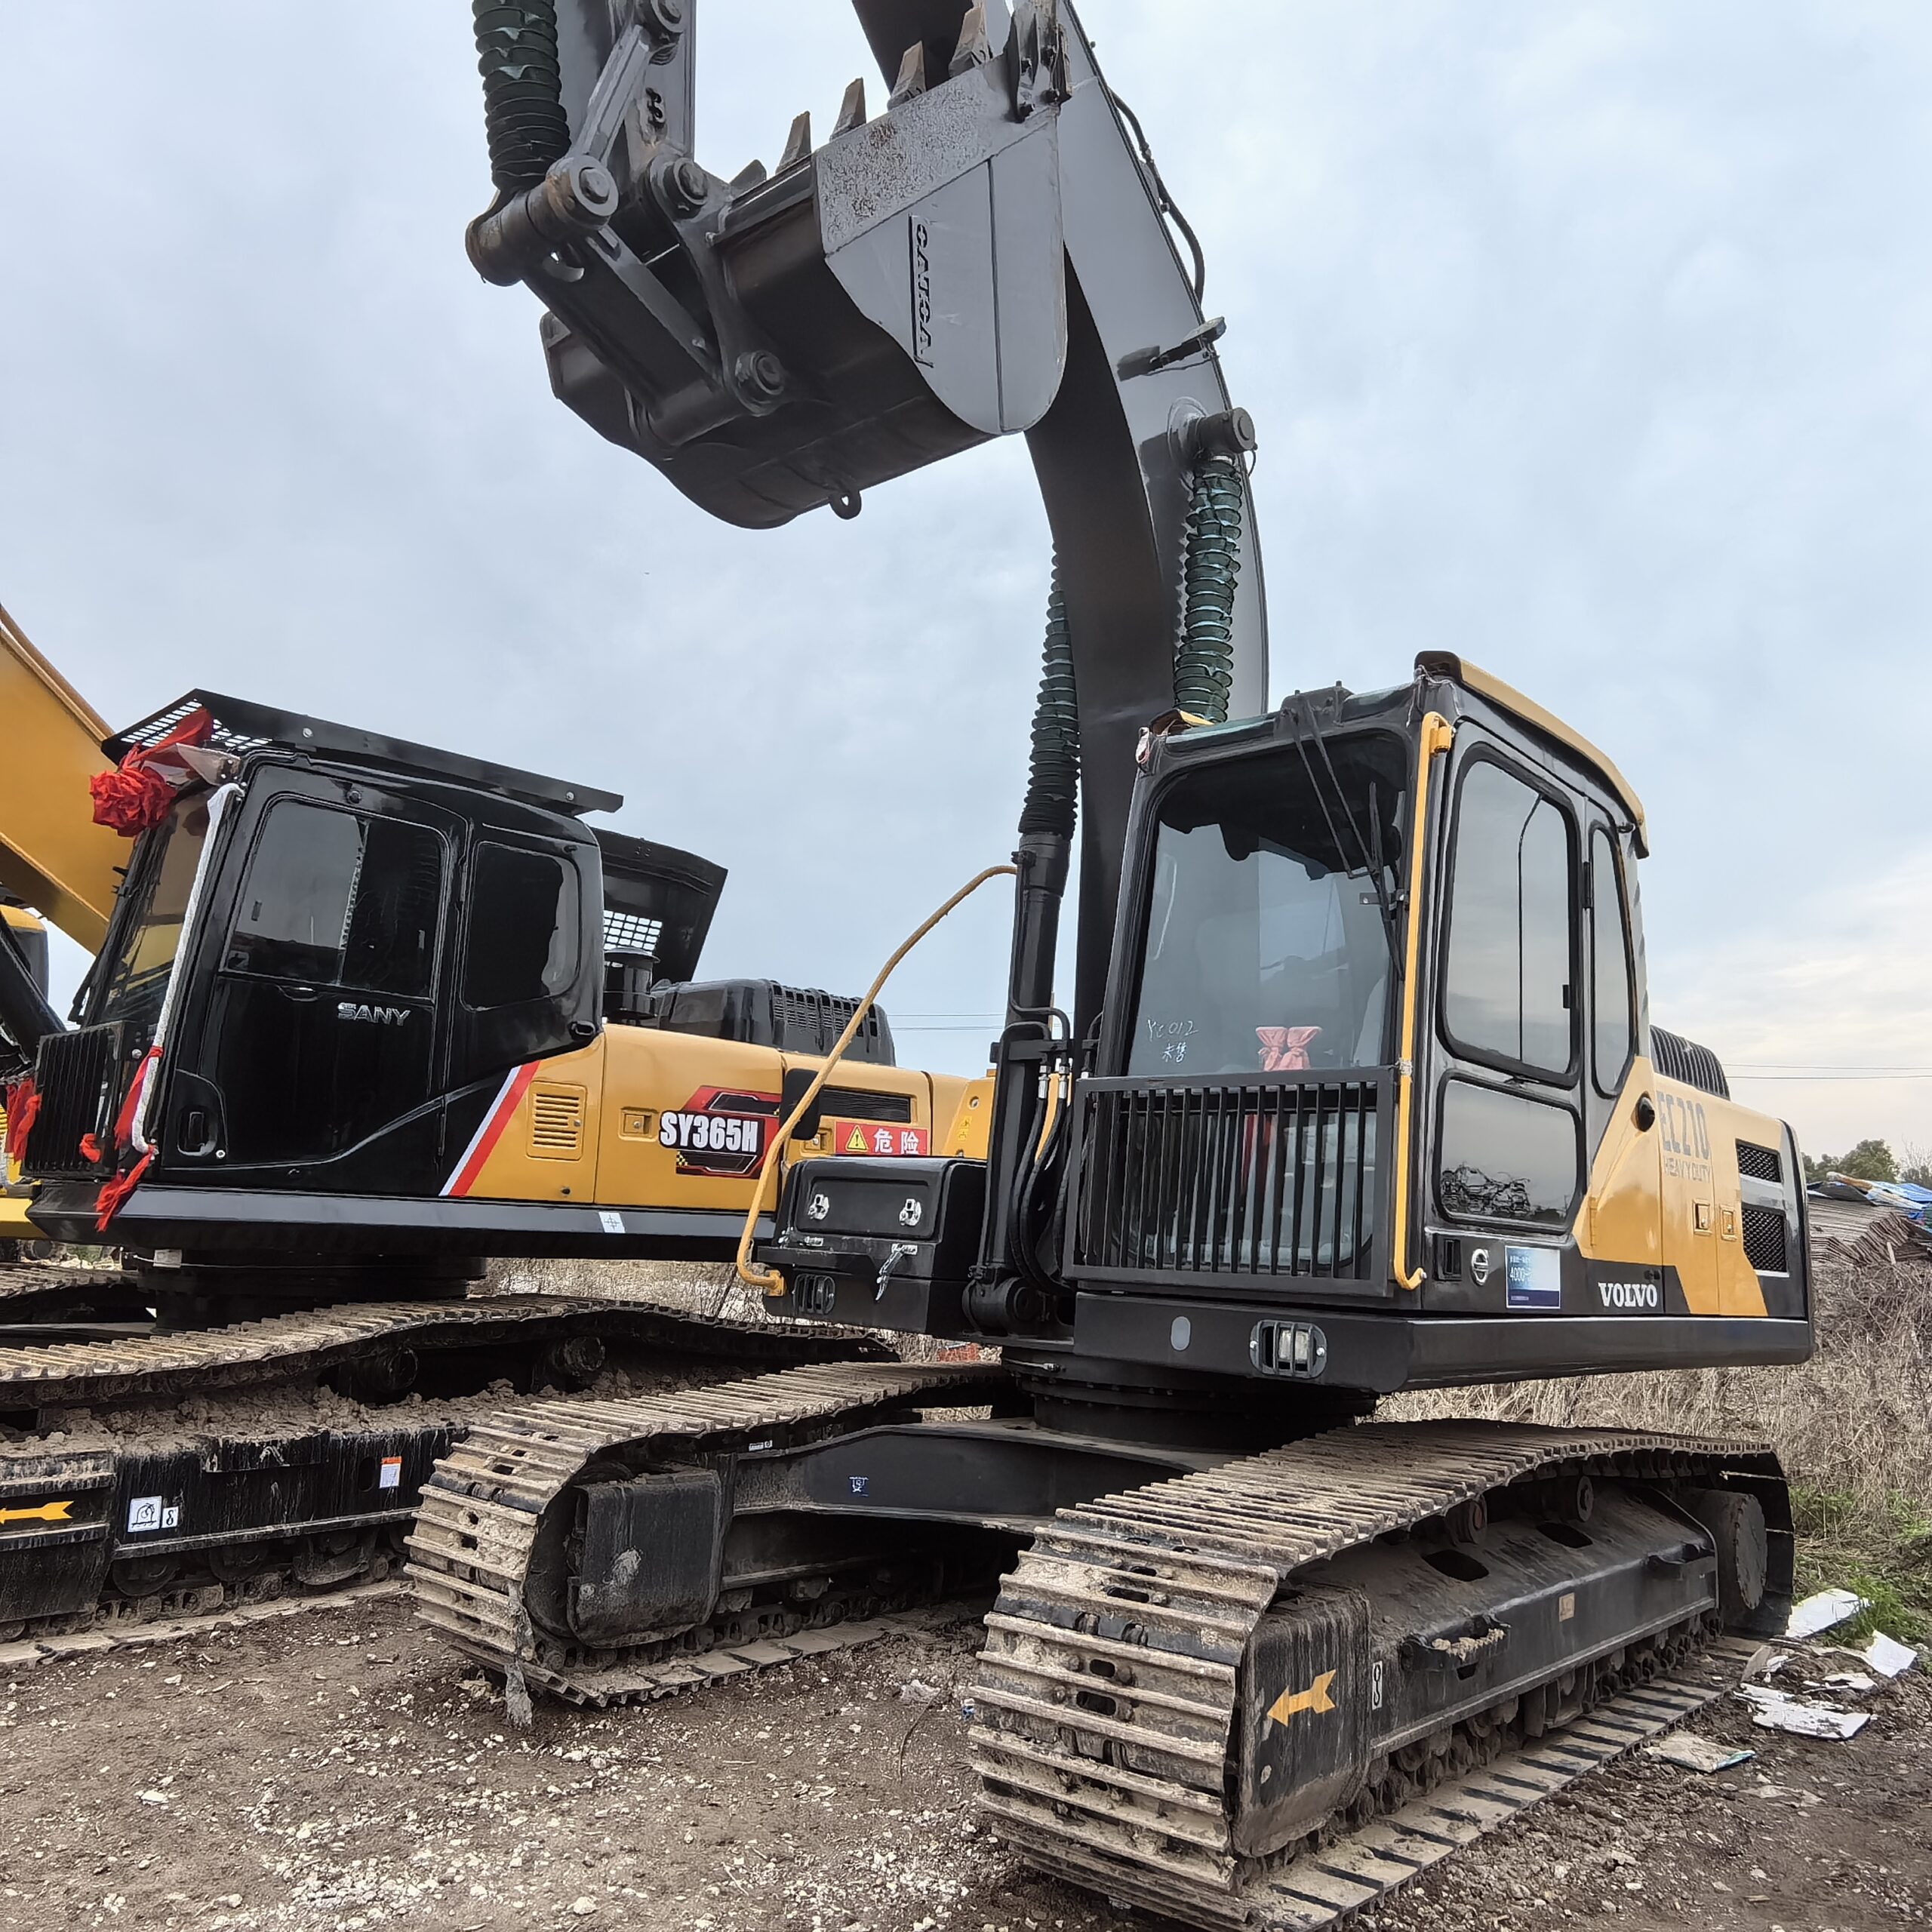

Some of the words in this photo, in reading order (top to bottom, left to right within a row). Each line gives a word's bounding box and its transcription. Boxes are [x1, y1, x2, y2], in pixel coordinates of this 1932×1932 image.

[337, 1001, 411, 1026] SANY
[660, 1111, 758, 1152] SY365H
[873, 1128, 920, 1155] 危险
[1598, 1281, 1658, 1307] VOLVO
